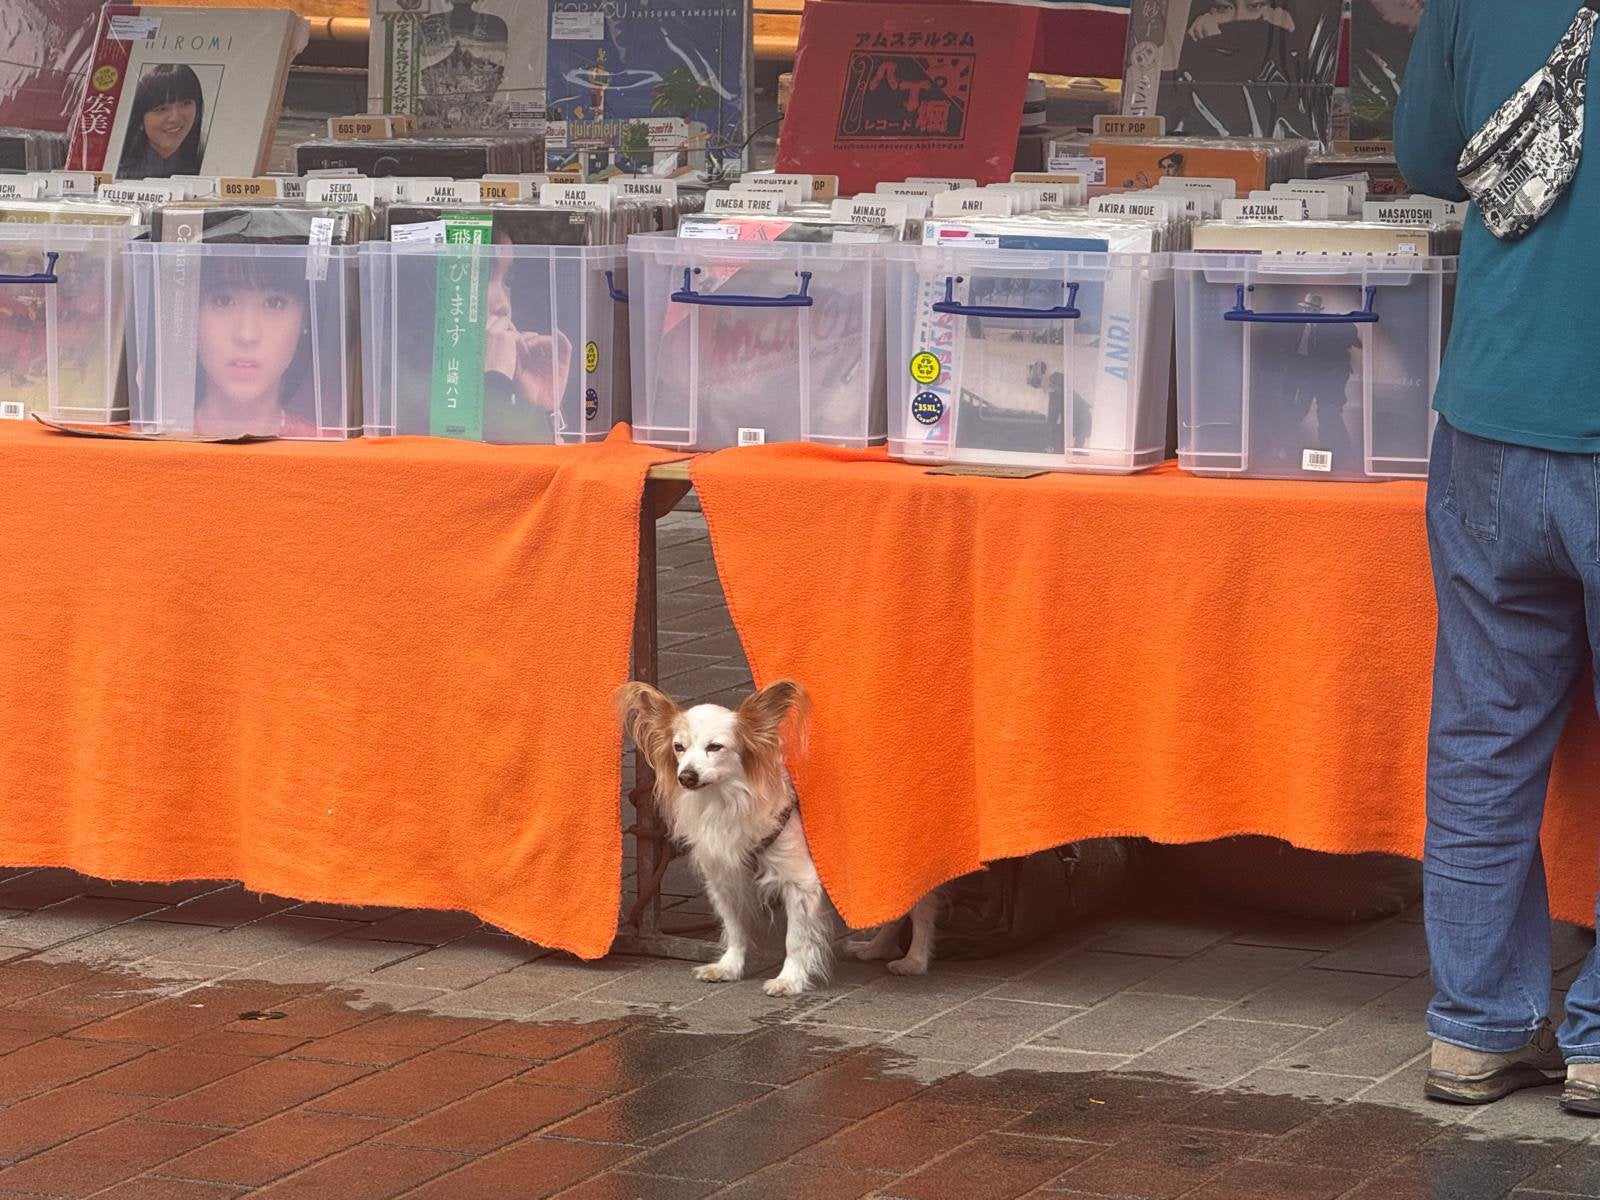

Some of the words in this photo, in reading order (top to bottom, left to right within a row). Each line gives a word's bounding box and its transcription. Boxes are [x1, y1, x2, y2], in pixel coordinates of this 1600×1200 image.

[631, 9, 677, 18] TATSURO
[681, 8, 737, 17] YAMASHITA
[856, 32, 975, 48] アムステルダム
[82, 93, 113, 135] 宏美
[356, 124, 372, 133] POP
[864, 119, 912, 130] レコード
[1105, 123, 1128, 133] CITY
[1130, 123, 1145, 133] POP
[1495, 161, 1532, 201] VISION
[244, 185, 260, 194] POP
[329, 184, 352, 193] SEIKO
[434, 187, 455, 196] MAKI
[487, 188, 507, 198] FOLK
[624, 184, 662, 194] TRANSAM
[103, 188, 135, 200] YELLOW
[137, 192, 163, 203] MAGIC
[321, 193, 358, 202] MATSUDA
[565, 190, 586, 200] HAKO
[1040, 192, 1057, 201] SHI
[715, 199, 744, 209] OMEGA
[748, 200, 771, 210] TRIBE
[962, 200, 982, 210] ANRI
[1098, 203, 1125, 214] AKIRA
[1129, 205, 1155, 216] INOUE
[853, 205, 886, 216] MINAKO
[1242, 205, 1277, 215] KAZUMI
[1378, 208, 1432, 219] MASAYOSHI
[1104, 314, 1131, 381] ANRI
[918, 403, 937, 412] 35XL
